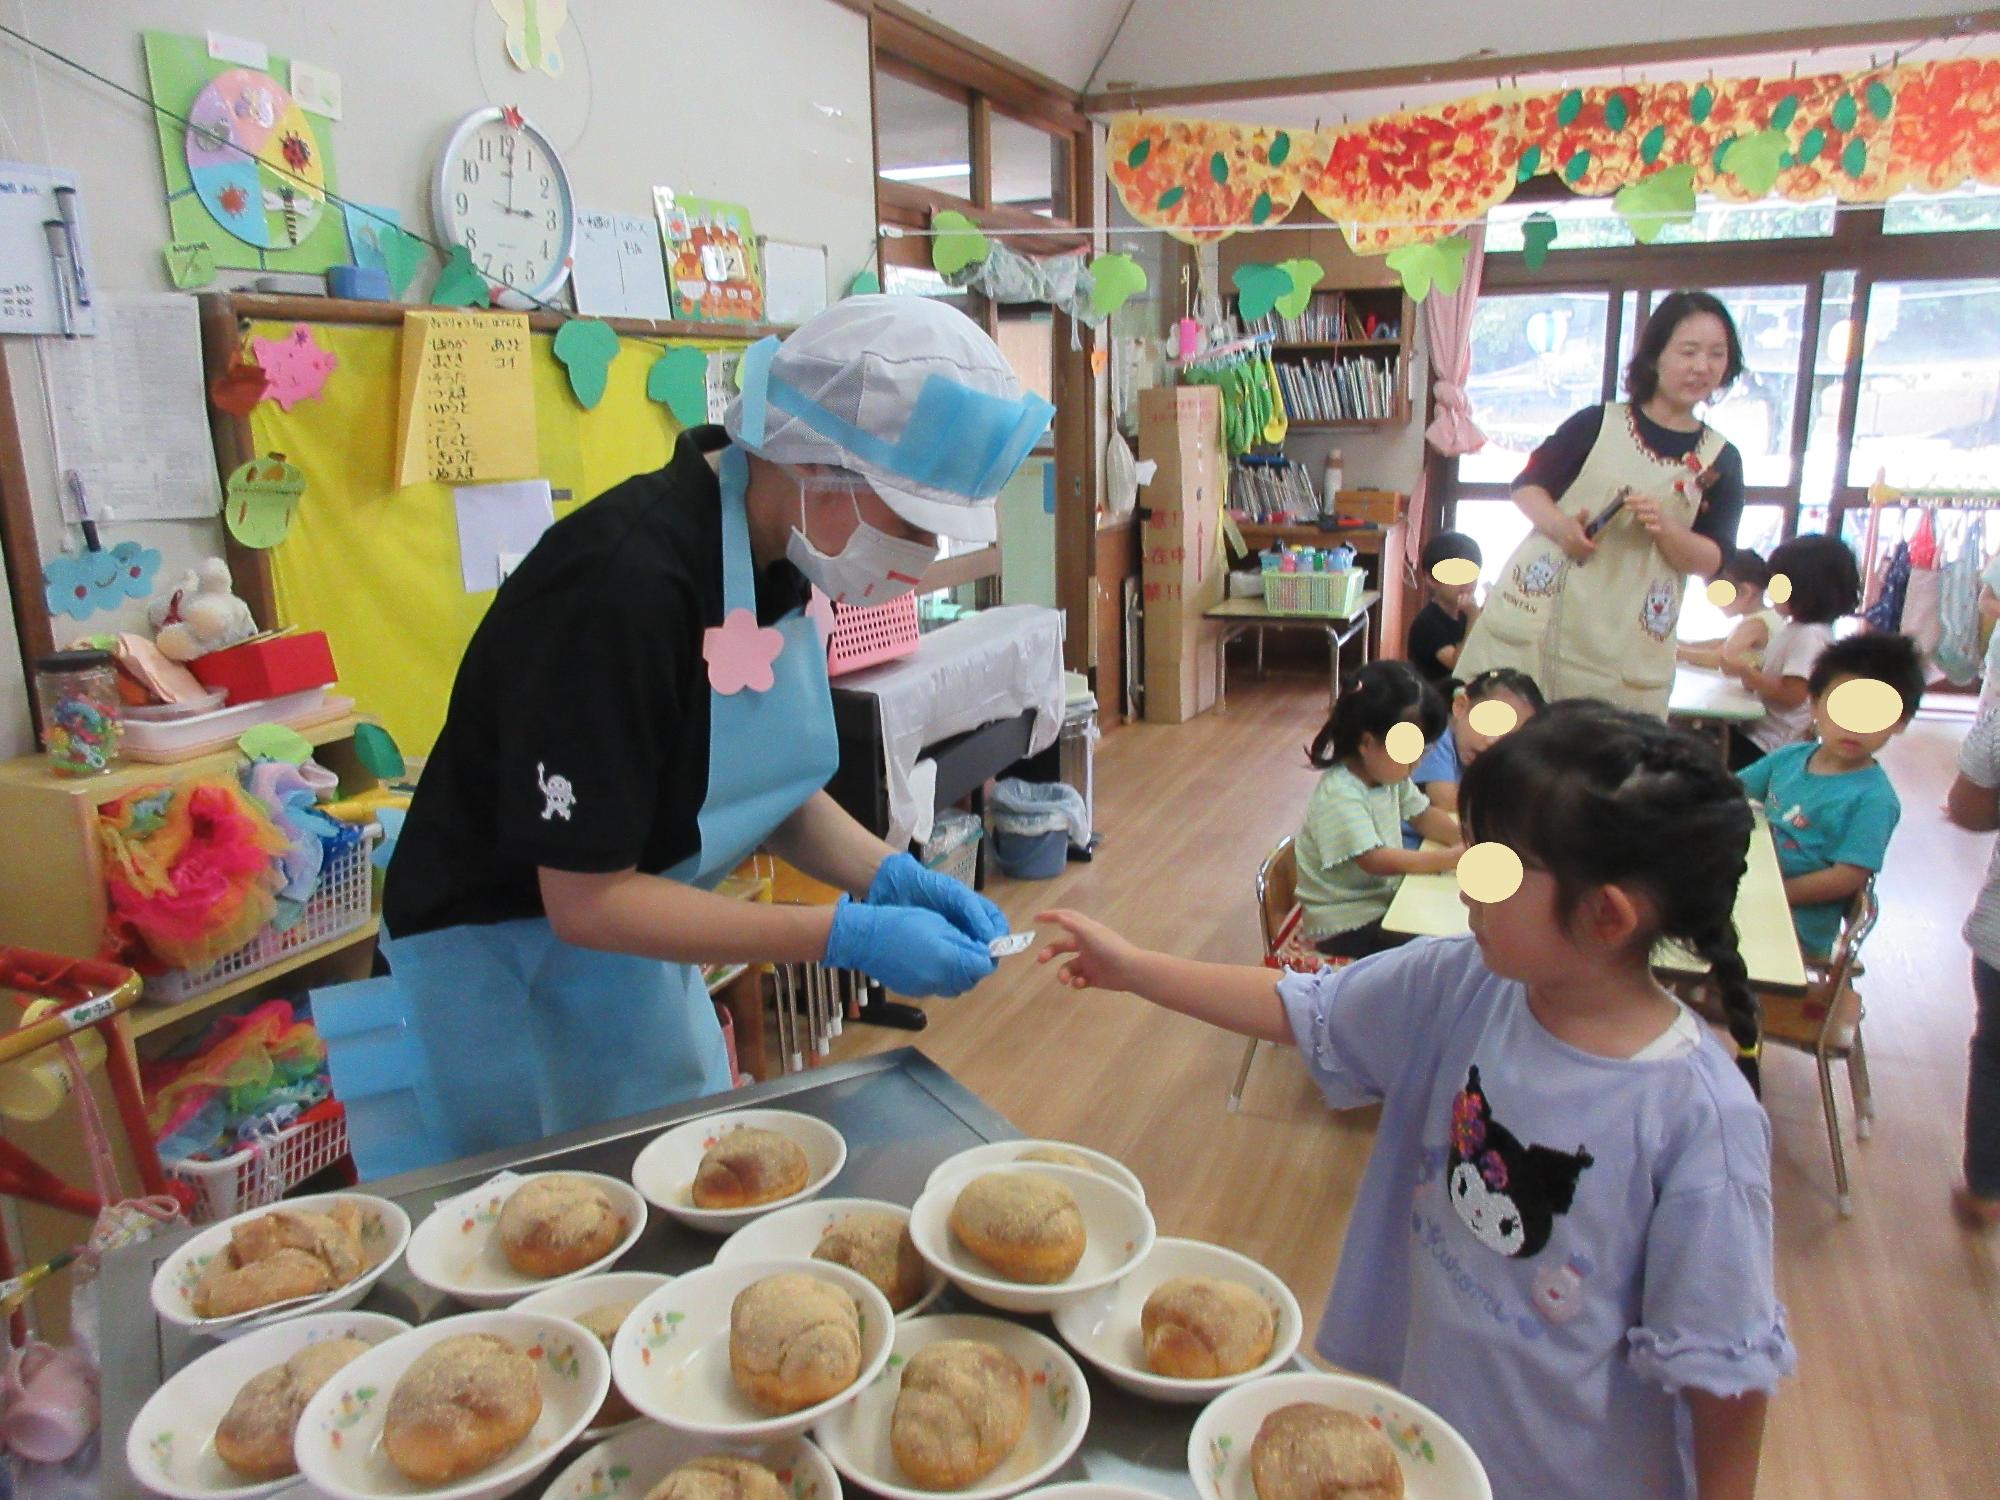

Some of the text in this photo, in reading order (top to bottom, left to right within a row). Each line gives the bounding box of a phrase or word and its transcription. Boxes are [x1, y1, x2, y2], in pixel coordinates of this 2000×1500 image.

[479, 138, 491, 162] 11
[527, 149, 532, 171] 1
[463, 159, 479, 184] 10
[539, 176, 549, 199] 2
[456, 192, 469, 215] 9
[546, 209, 557, 232] 3
[465, 227, 477, 249] 8
[540, 239, 549, 259] 4
[481, 253, 493, 275] 7
[502, 263, 514, 285] 6
[525, 260, 535, 281] 5
